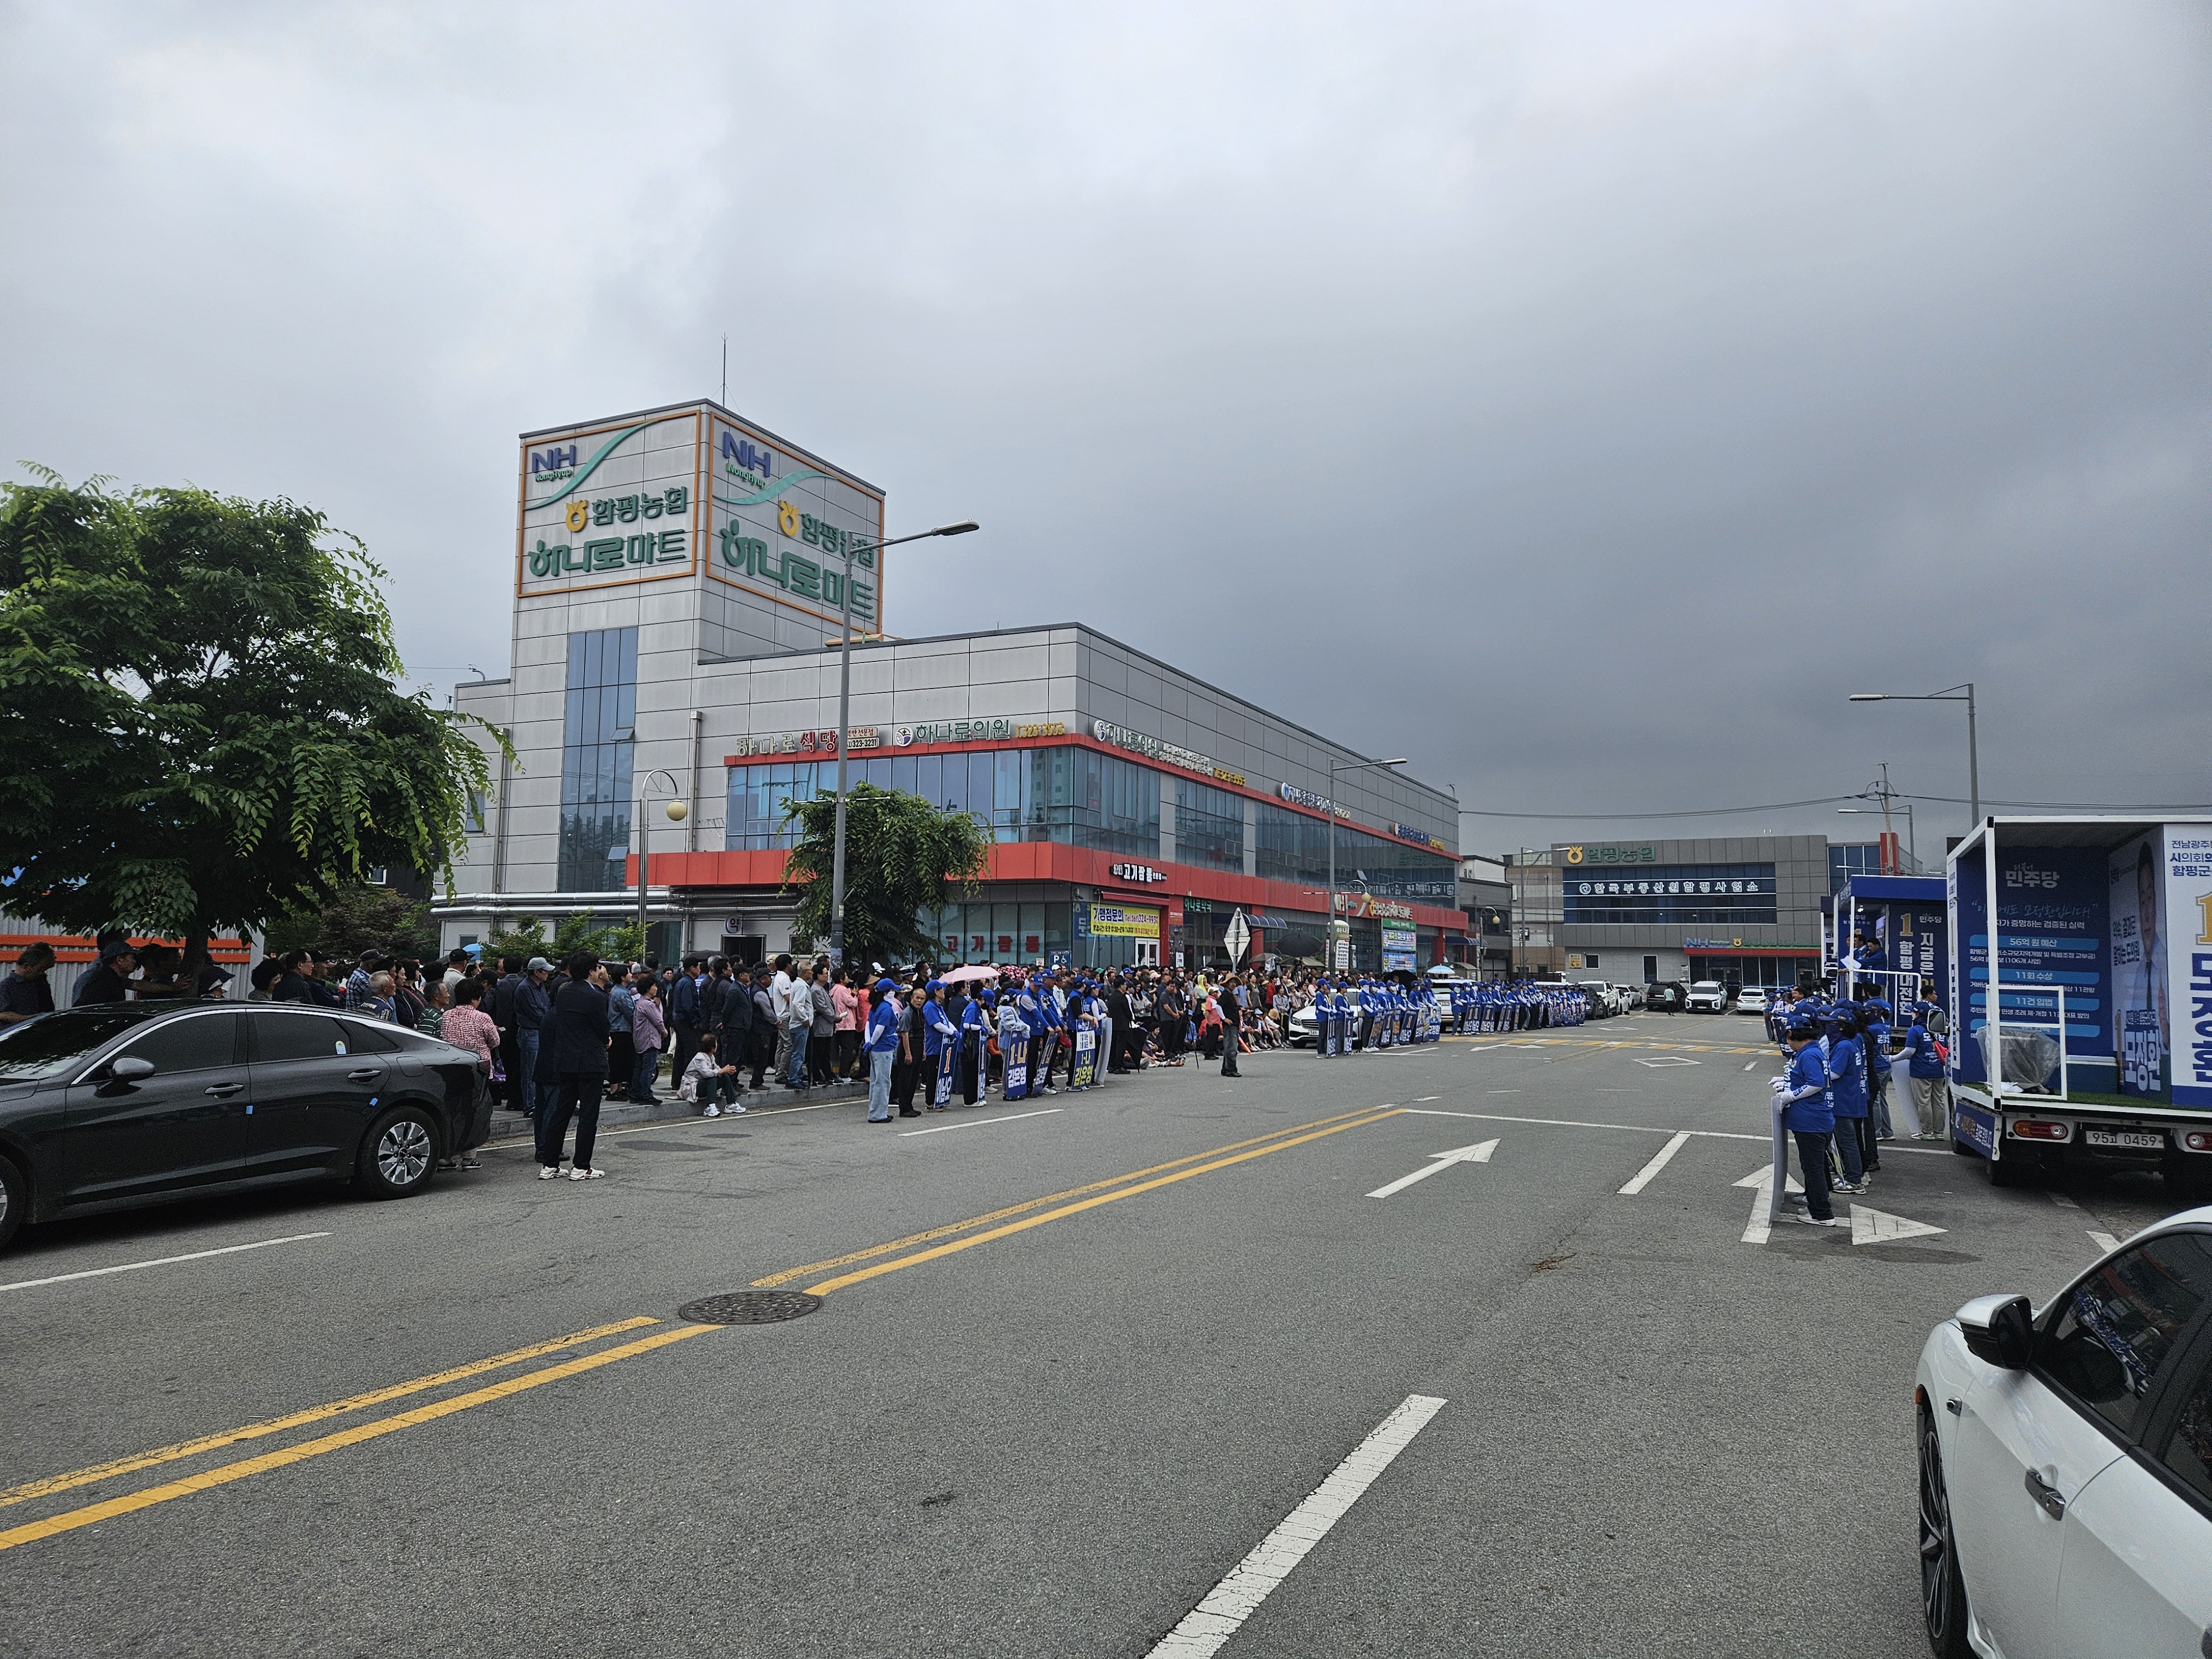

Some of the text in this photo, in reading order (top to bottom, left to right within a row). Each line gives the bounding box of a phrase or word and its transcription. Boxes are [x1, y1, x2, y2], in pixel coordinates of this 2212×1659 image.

[531, 444, 576, 473] NH
[723, 431, 770, 478] NH
[535, 469, 573, 482] NongHyup
[726, 462, 766, 489] NongHyup
[592, 486, 687, 526] 함평농협
[527, 529, 686, 576] 하나로마트
[916, 719, 1010, 744] 하나로의원
[1124, 863, 1152, 883] 고기짬뽕
[2006, 870, 2060, 888] 민주당
[730, 918, 740, 931] 약
[1900, 913, 1913, 937] 1
[2011, 920, 2042, 928] 증명하는
[1687, 938, 1709, 947] NH
[2009, 938, 2030, 947] 56억
[2041, 939, 2057, 947] 예산
[1053, 955, 1060, 963] P
[1899, 940, 1914, 969] 함평
[1919, 932, 1934, 976] 지금은
[2015, 971, 2053, 980] 11회 수상
[2016, 997, 2053, 1006] 11건 입법
[943, 1047, 952, 1074] 1
[2125, 1030, 2161, 1091] 모정환
[1008, 1066, 1027, 1088] 김은영
[1074, 1065, 1093, 1087] 김은영
[2093, 1133, 2157, 1146] 95고 0459
